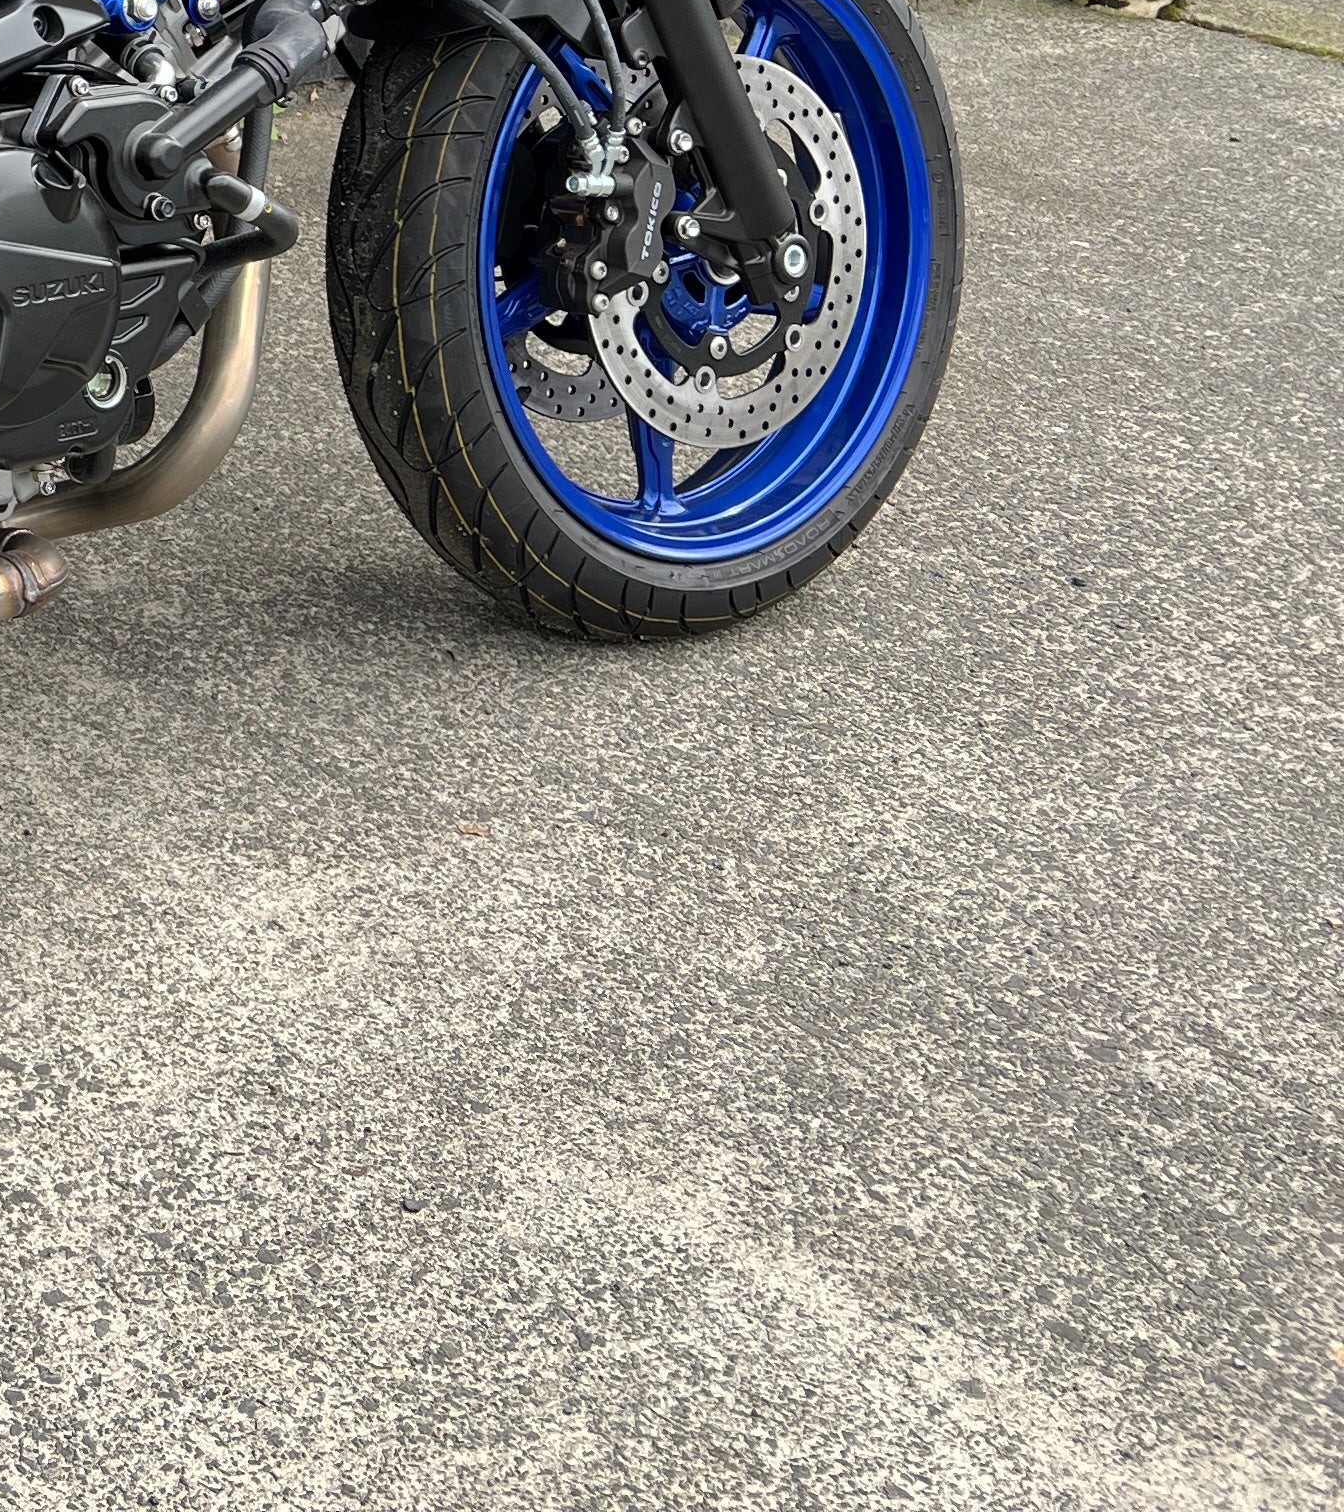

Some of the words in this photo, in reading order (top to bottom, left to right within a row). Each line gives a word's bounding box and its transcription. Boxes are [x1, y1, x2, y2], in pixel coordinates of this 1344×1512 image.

[640, 181, 662, 260] TOKICO
[12, 272, 106, 308] SUZUKI
[728, 517, 831, 578] ROADSMART
